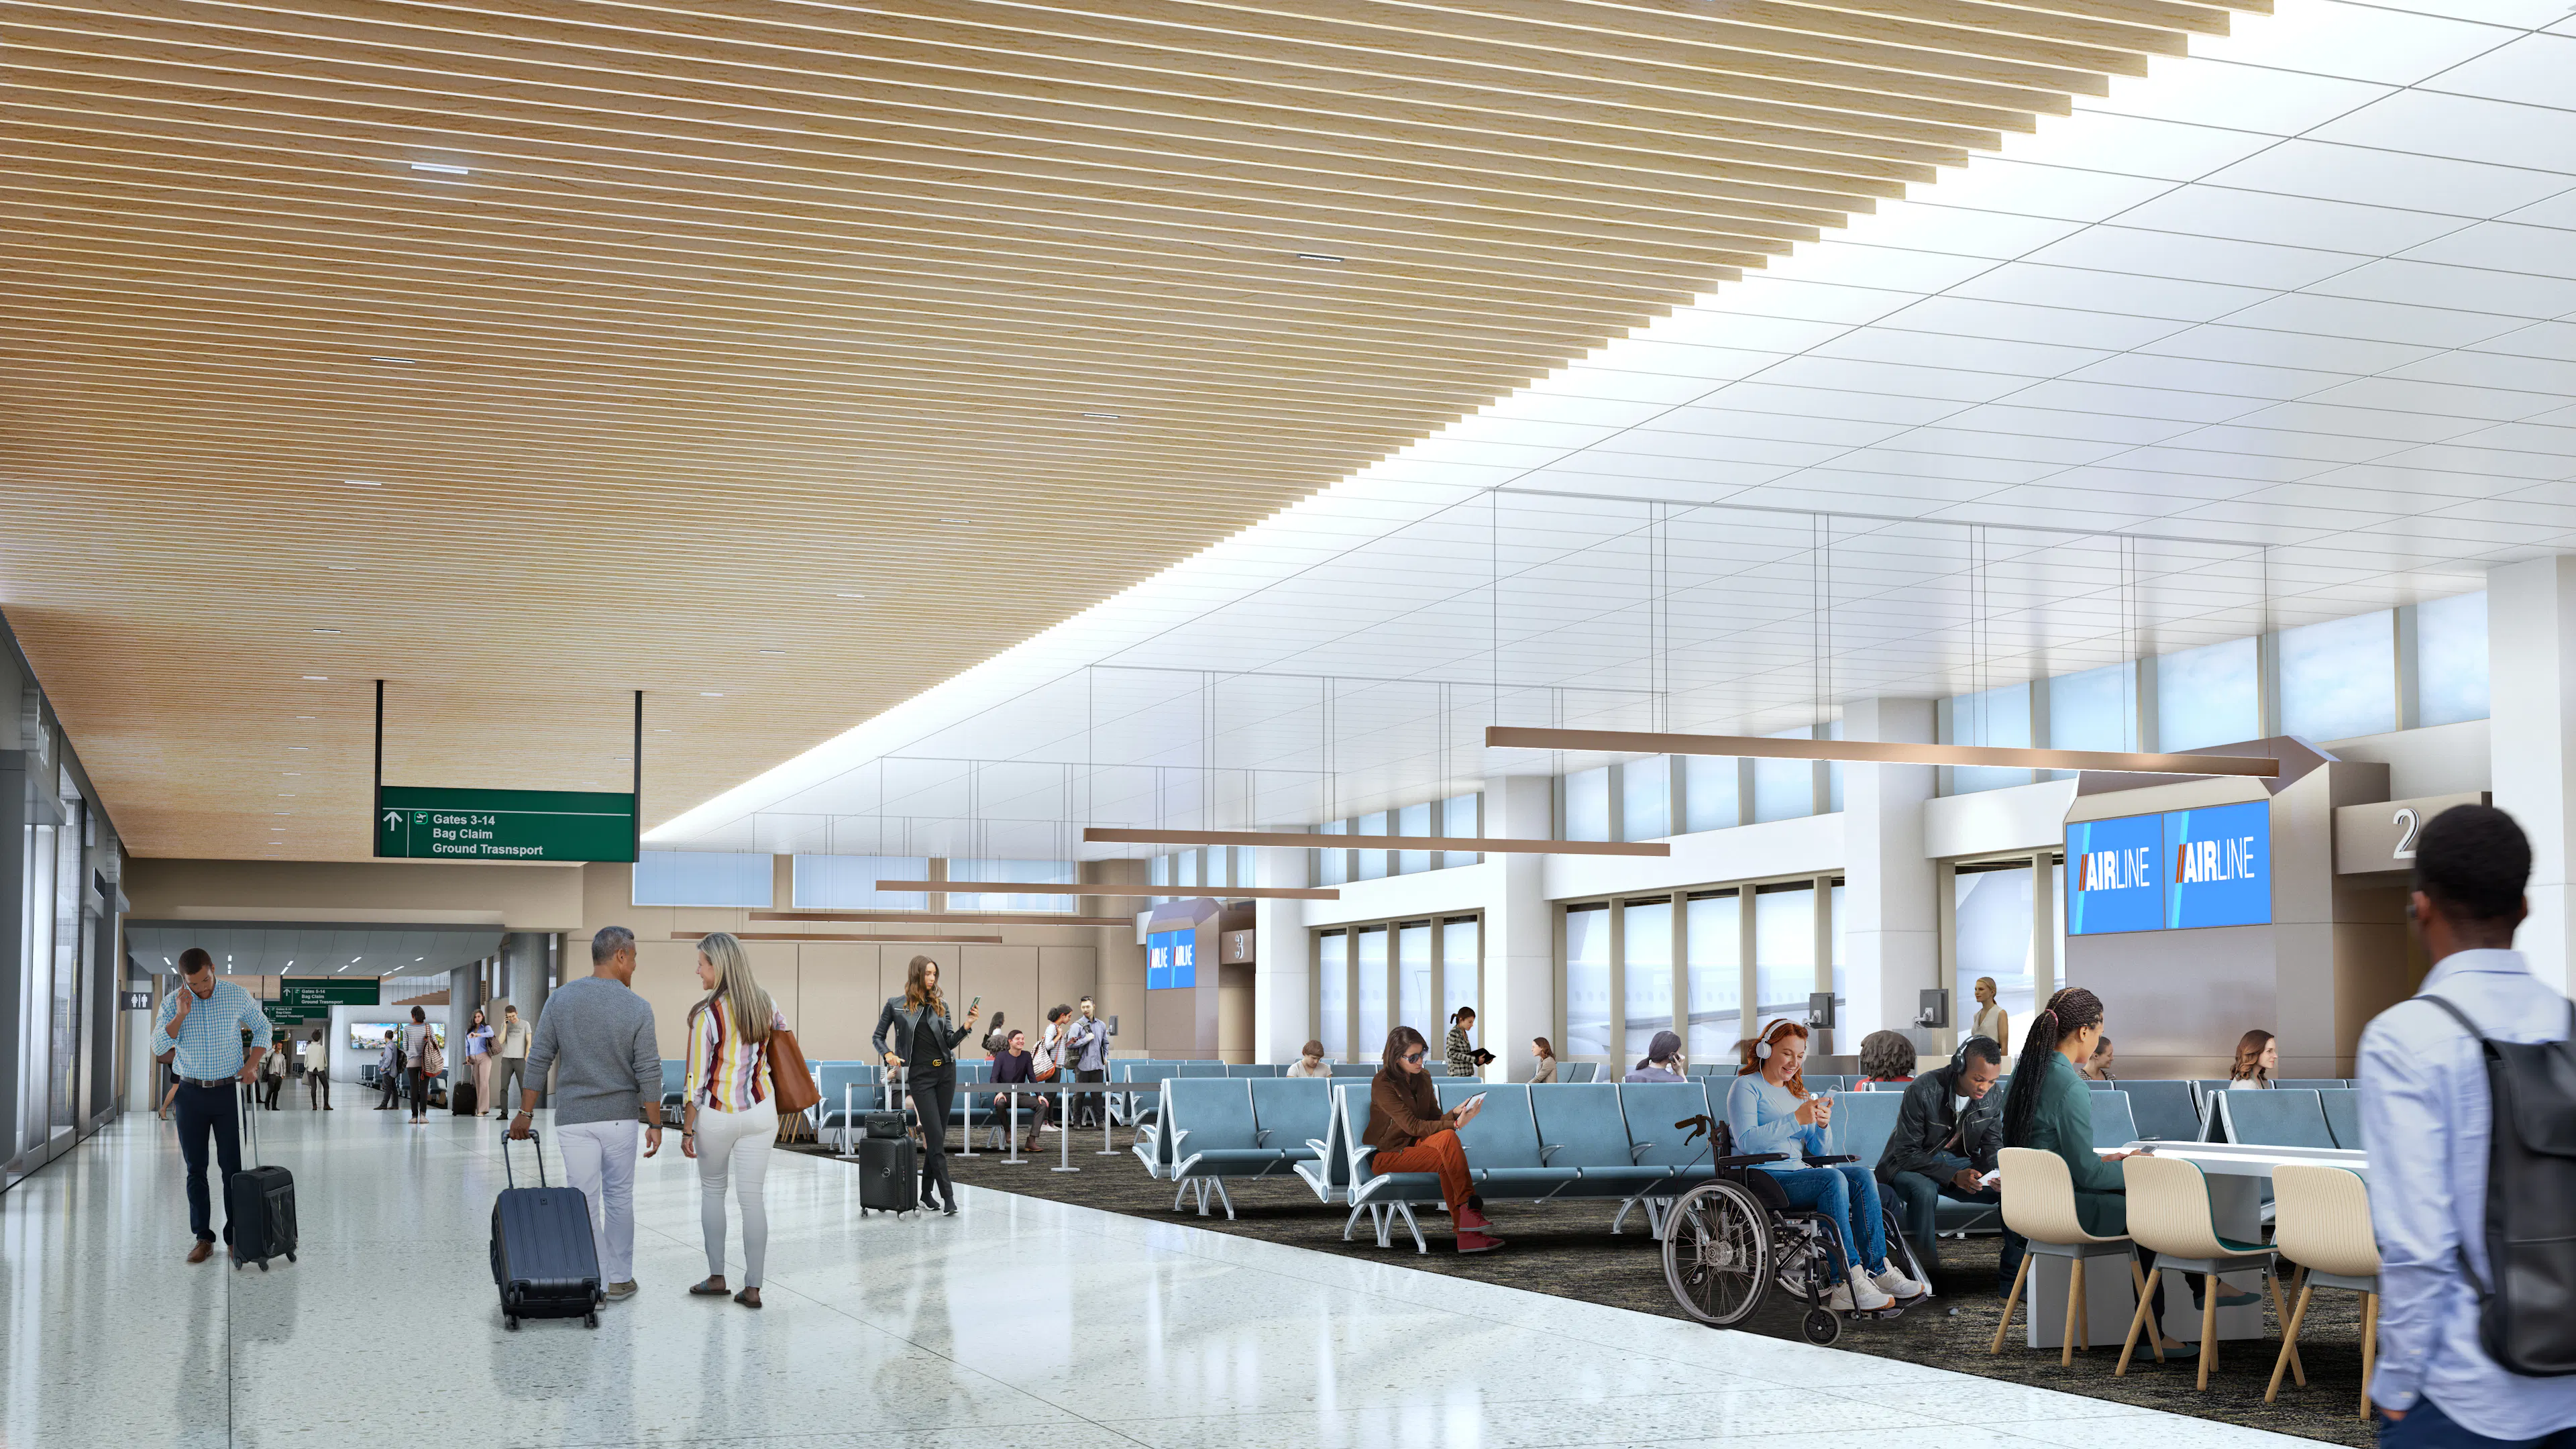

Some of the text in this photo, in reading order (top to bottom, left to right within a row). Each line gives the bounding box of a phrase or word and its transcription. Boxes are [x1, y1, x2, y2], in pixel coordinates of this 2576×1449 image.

[433, 814, 496, 826] Gates 3-14
[433, 828, 493, 841] Bag Claim
[2393, 808, 2419, 859] 2
[432, 843, 543, 857] Ground Trasnsport
[2184, 836, 2255, 883] AIRLINE
[2086, 847, 2150, 891] AIRLINE
[1175, 944, 1193, 967] AIRLINE
[1234, 933, 1244, 959] 3
[1150, 947, 1168, 969] AIRLINE
